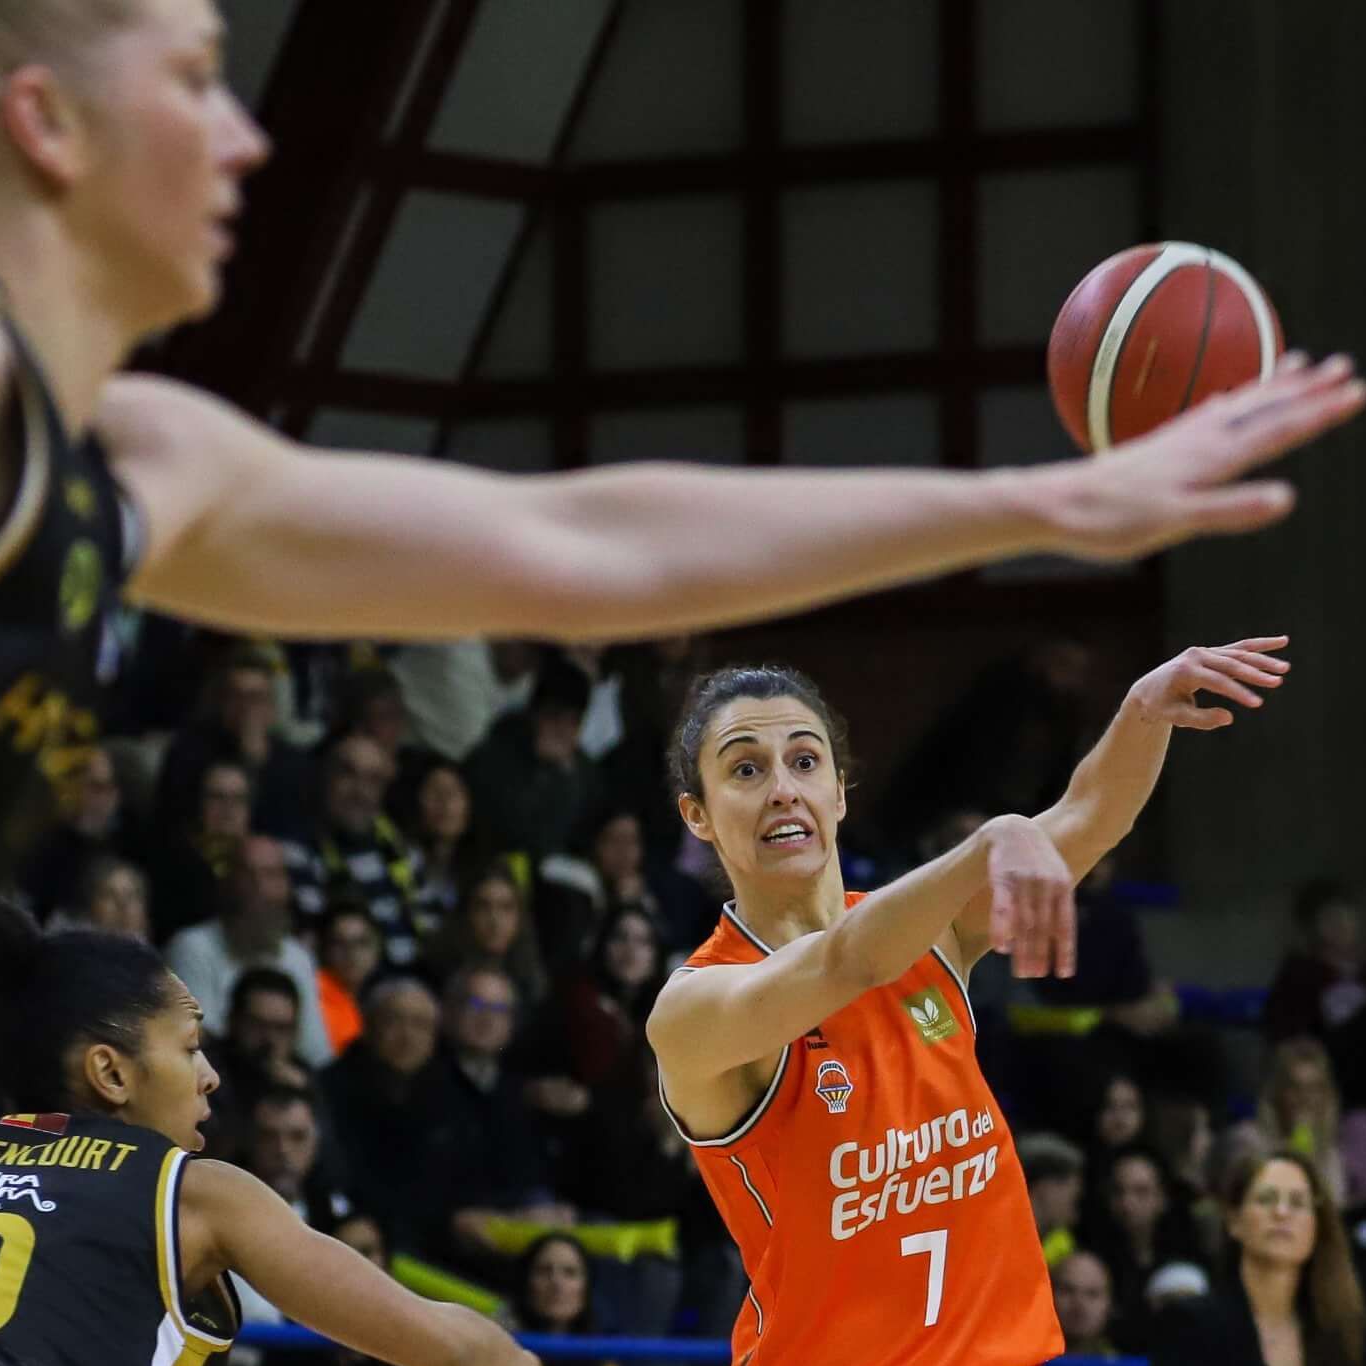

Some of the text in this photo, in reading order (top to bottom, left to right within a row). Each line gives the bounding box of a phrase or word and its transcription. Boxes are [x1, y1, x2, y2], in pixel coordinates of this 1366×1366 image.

[830, 1106, 995, 1188] Cultura del
[831, 1145, 998, 1240] Esfuerzo
[901, 1229, 948, 1327] 7
